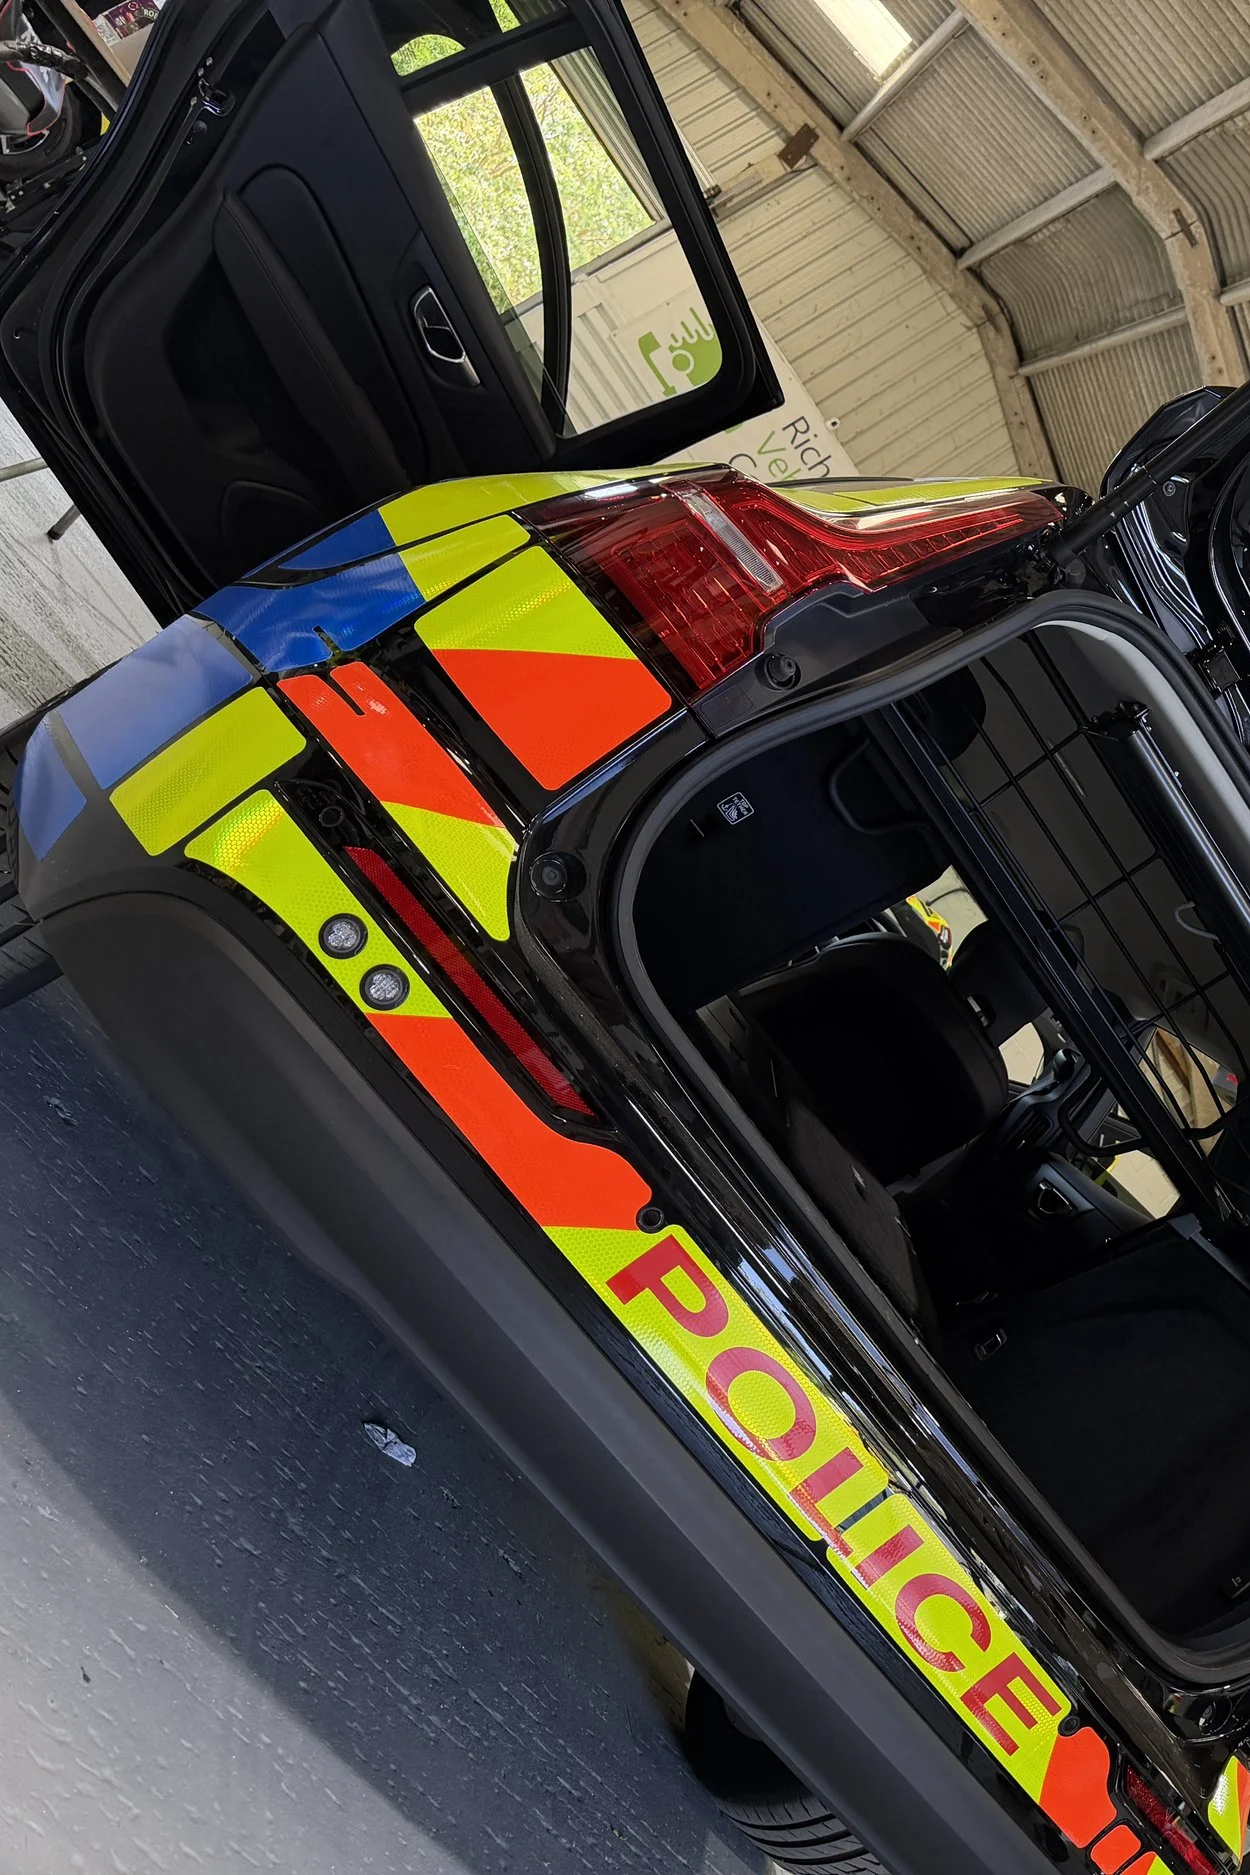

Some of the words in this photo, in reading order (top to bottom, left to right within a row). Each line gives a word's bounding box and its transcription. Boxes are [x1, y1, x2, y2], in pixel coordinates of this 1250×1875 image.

[732, 796, 748, 816] TETHER
[740, 798, 749, 809] TOP
[605, 1234, 1063, 1757] POLICE
